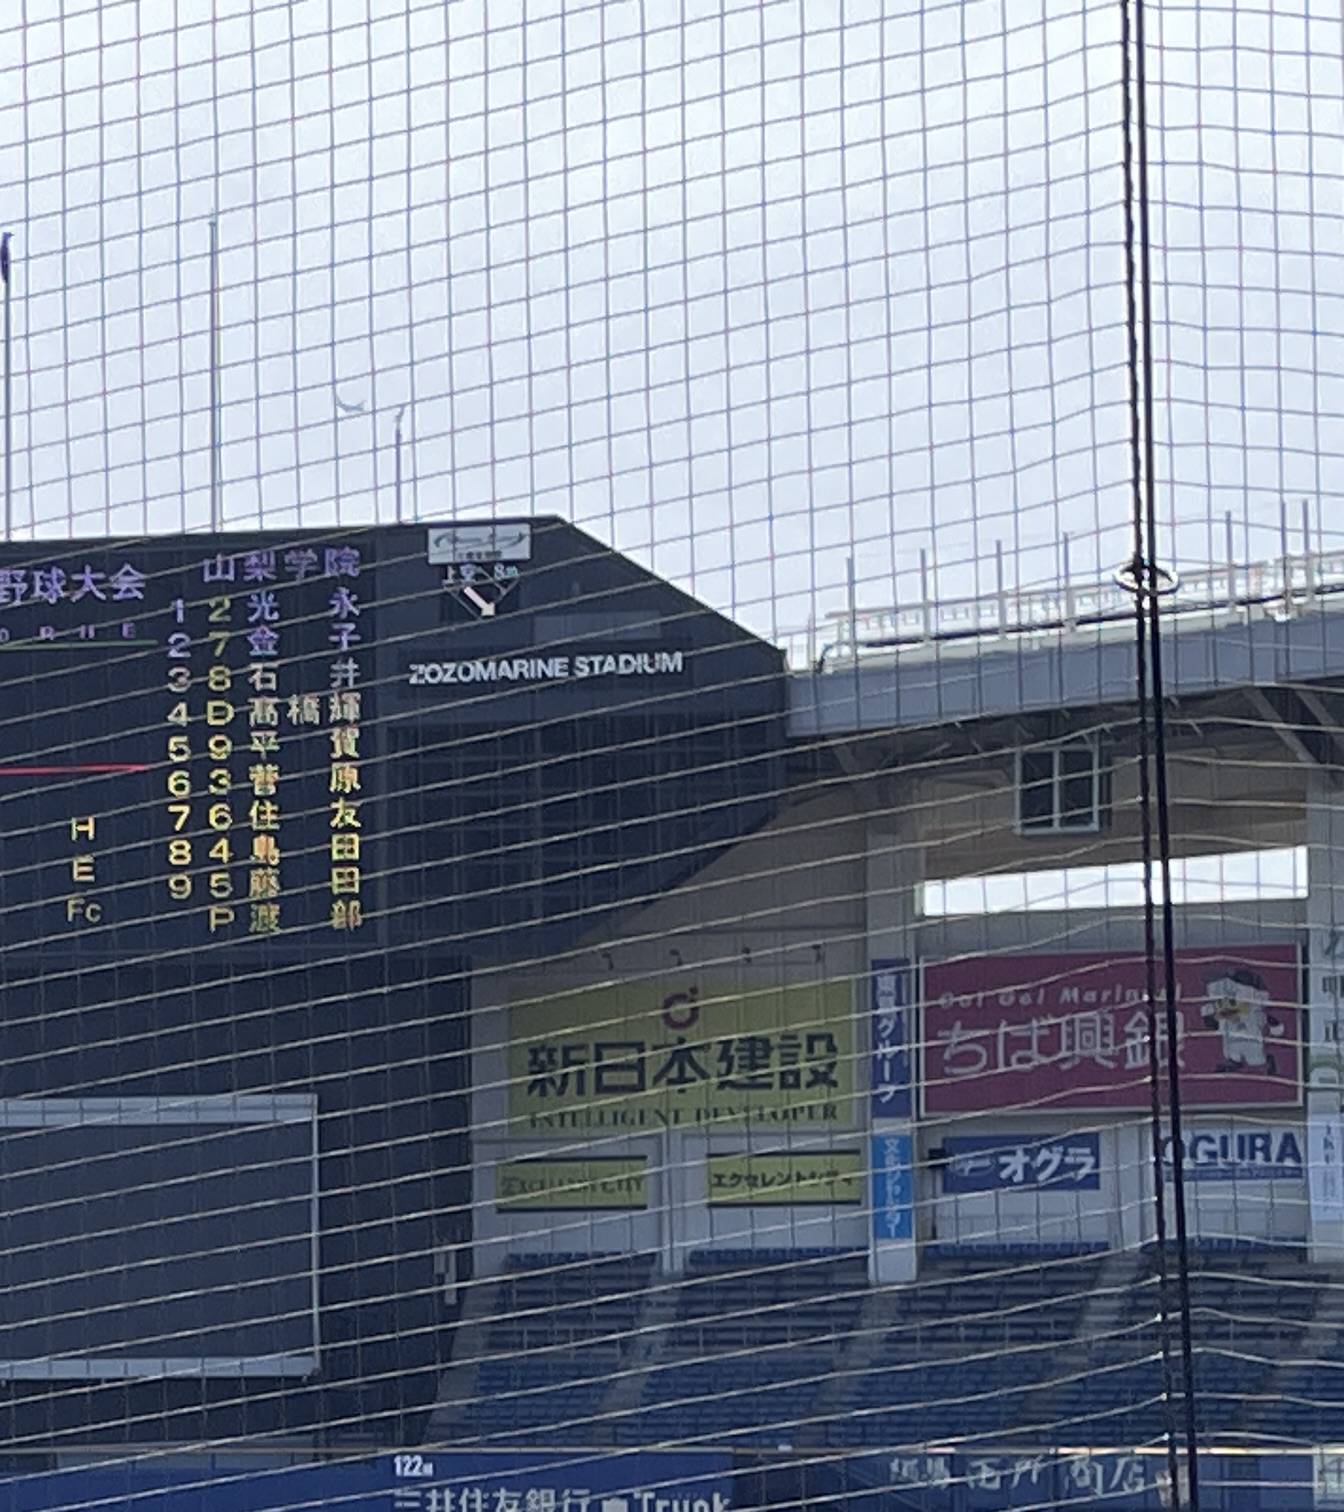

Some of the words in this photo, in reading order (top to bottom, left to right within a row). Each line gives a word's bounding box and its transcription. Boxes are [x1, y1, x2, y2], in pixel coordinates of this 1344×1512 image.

[203, 547, 361, 583] 山梨学院
[173, 598, 184, 623] 1
[209, 598, 231, 622] 2
[168, 633, 191, 658] 2
[209, 631, 230, 657] 7
[168, 667, 190, 693] 3
[208, 665, 231, 691] 8
[409, 658, 569, 684] ZOZOMARINE
[575, 652, 683, 677] STADIUM
[168, 702, 188, 727] 4
[207, 700, 234, 726] D
[168, 736, 191, 762] 5
[208, 735, 231, 760] 9
[168, 771, 190, 796] 6
[209, 769, 230, 795] 3
[71, 816, 95, 841] H
[168, 804, 190, 831] 7
[209, 803, 232, 830] 6
[169, 839, 191, 865] 8
[209, 838, 232, 863] 4
[73, 856, 95, 882] E
[169, 873, 191, 899] 9
[209, 871, 232, 897] 5
[210, 906, 234, 932] P
[527, 1032, 840, 1098] 新日本建設
[1161, 1131, 1303, 1166] OGURA
[999, 1145, 1098, 1183] オグラ
